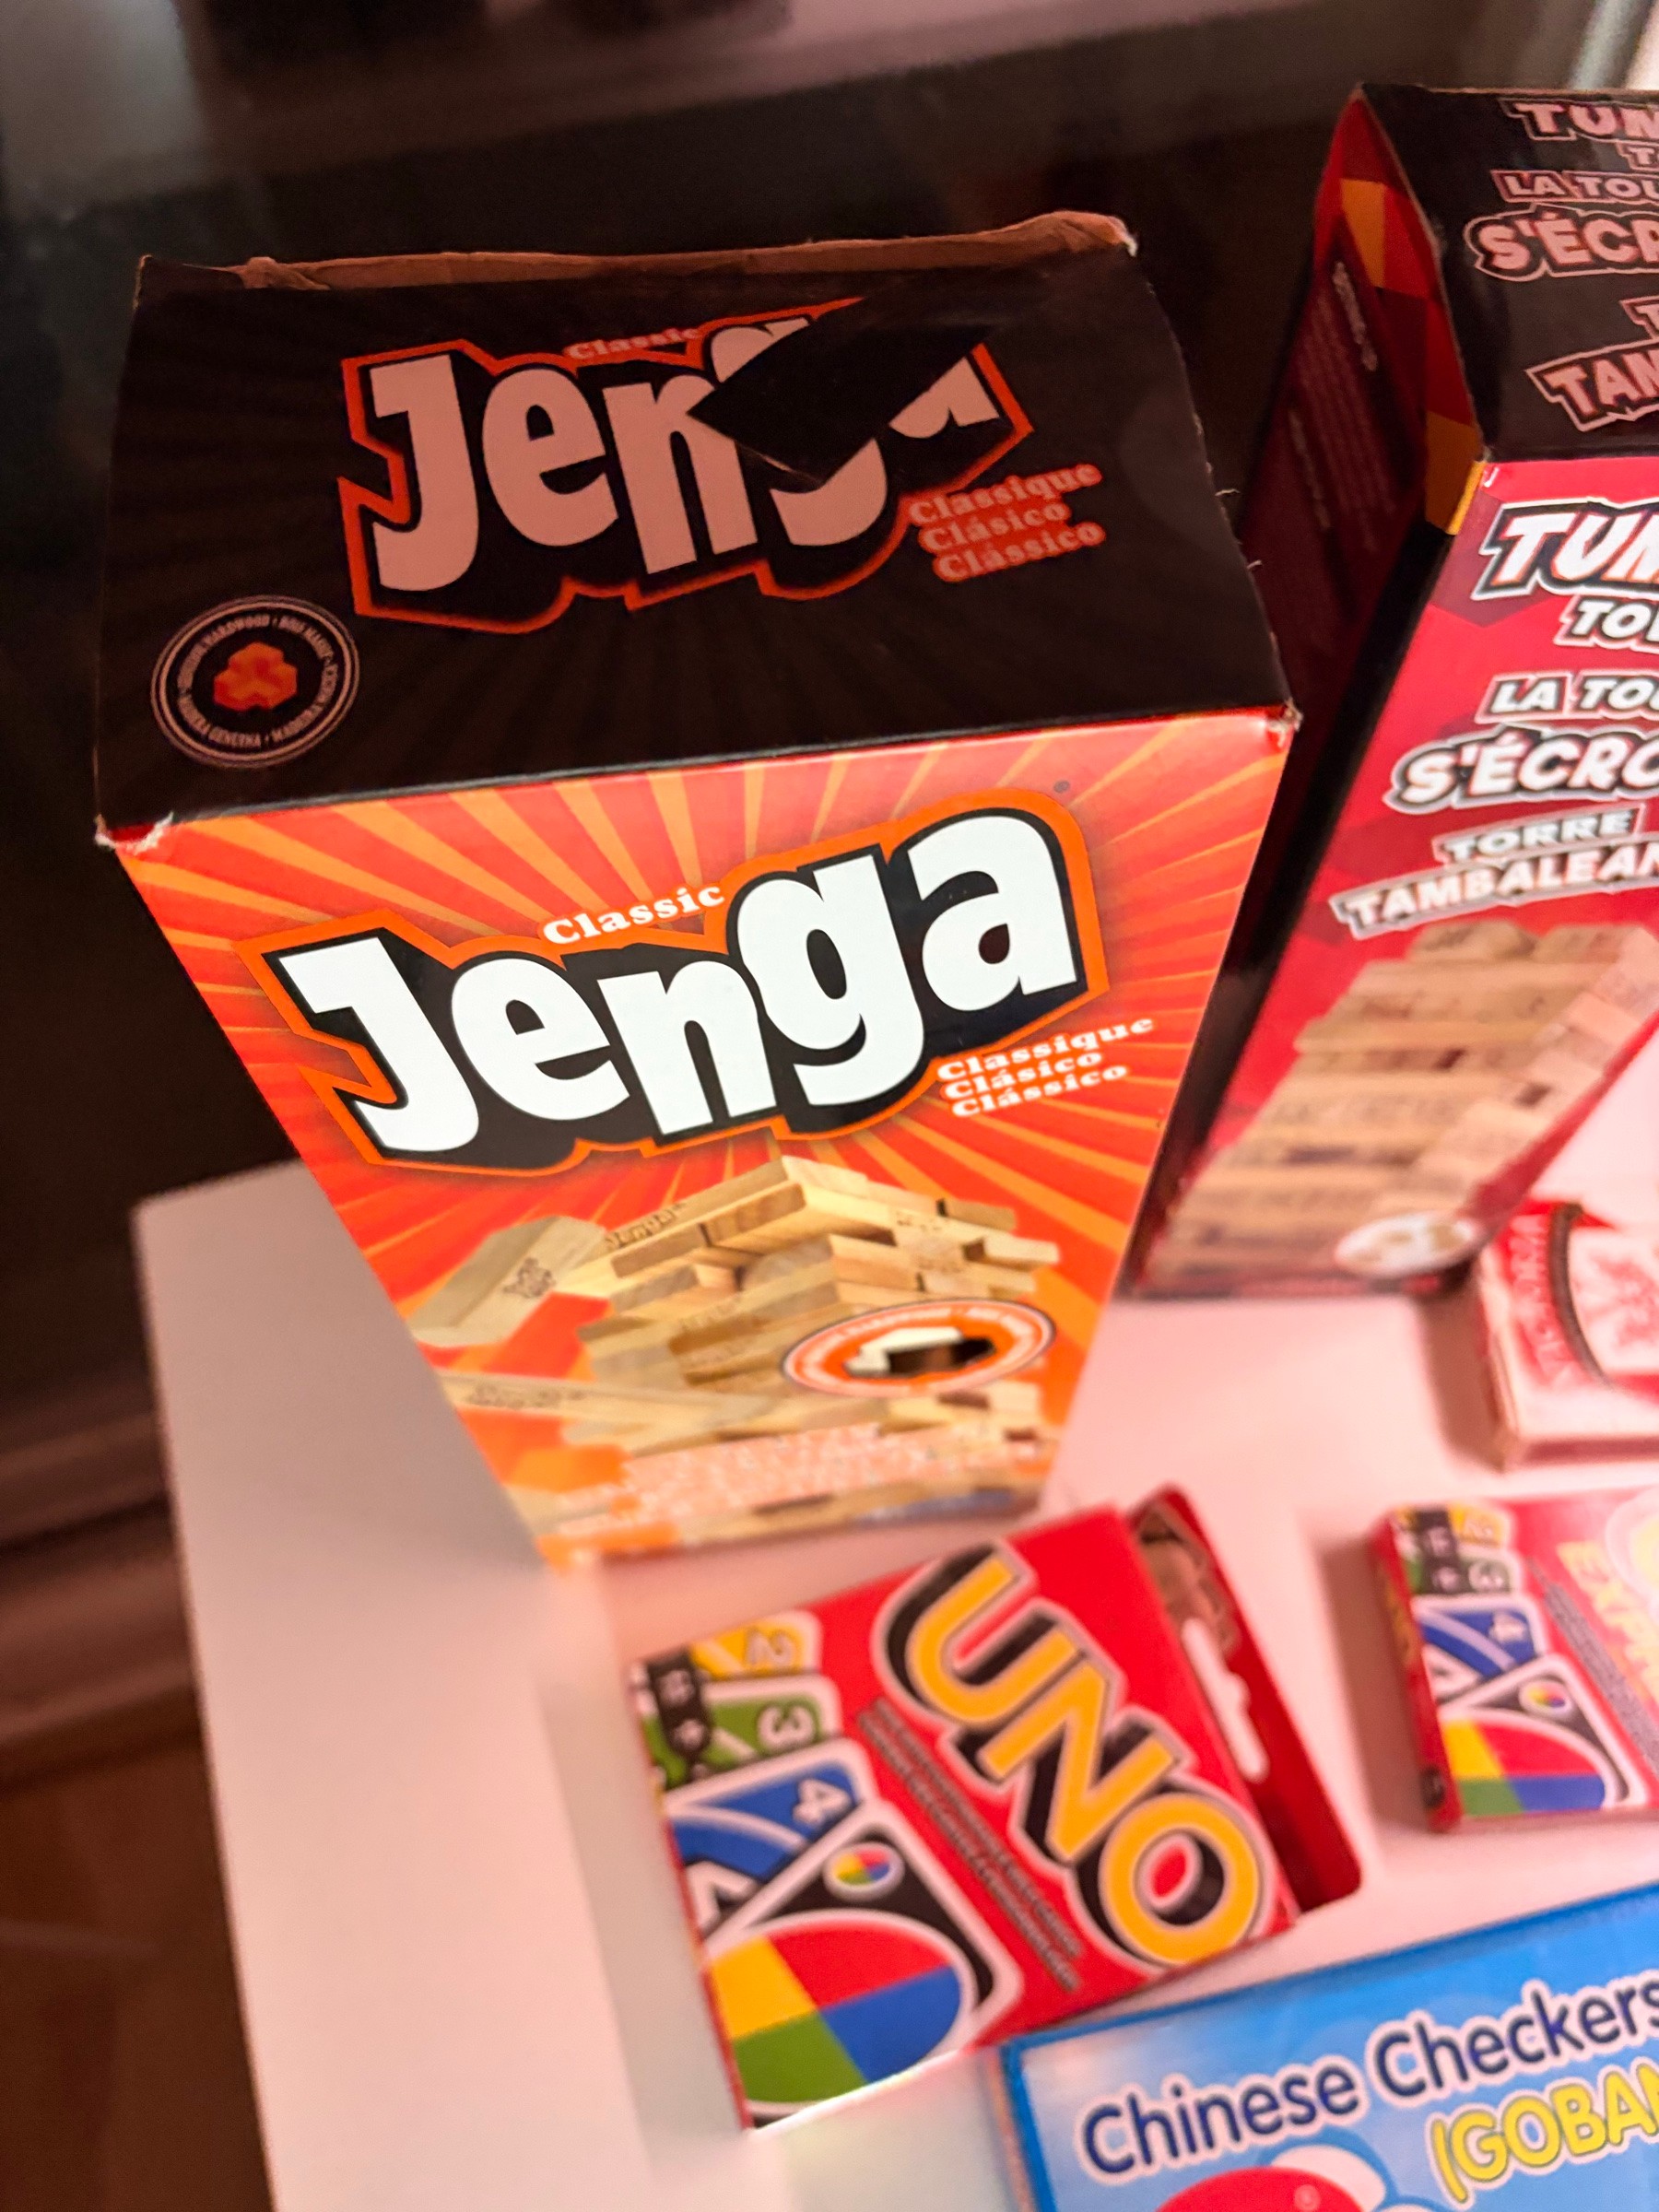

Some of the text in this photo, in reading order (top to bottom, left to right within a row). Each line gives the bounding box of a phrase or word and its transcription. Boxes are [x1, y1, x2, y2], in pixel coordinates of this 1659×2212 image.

[1502, 174, 1566, 196] LA
[569, 328, 699, 360] Classic
[909, 465, 1100, 524] Classique
[923, 501, 1068, 552] Clásico
[937, 523, 1103, 580] Clássico
[1571, 600, 1659, 642] TO
[1490, 679, 1559, 713] LA
[1444, 809, 1635, 863] TORRE
[543, 886, 725, 945] Classic
[278, 815, 1077, 1154] Jenga
[936, 1018, 1155, 1080] Classique
[944, 1052, 1103, 1099] Clásico
[951, 1065, 1128, 1117] Clássico
[756, 1704, 817, 1752] 3
[907, 1555, 1261, 1966] UNO
[793, 1777, 853, 1826] 4
[1083, 1979, 1659, 2174] Chinese Checkers
